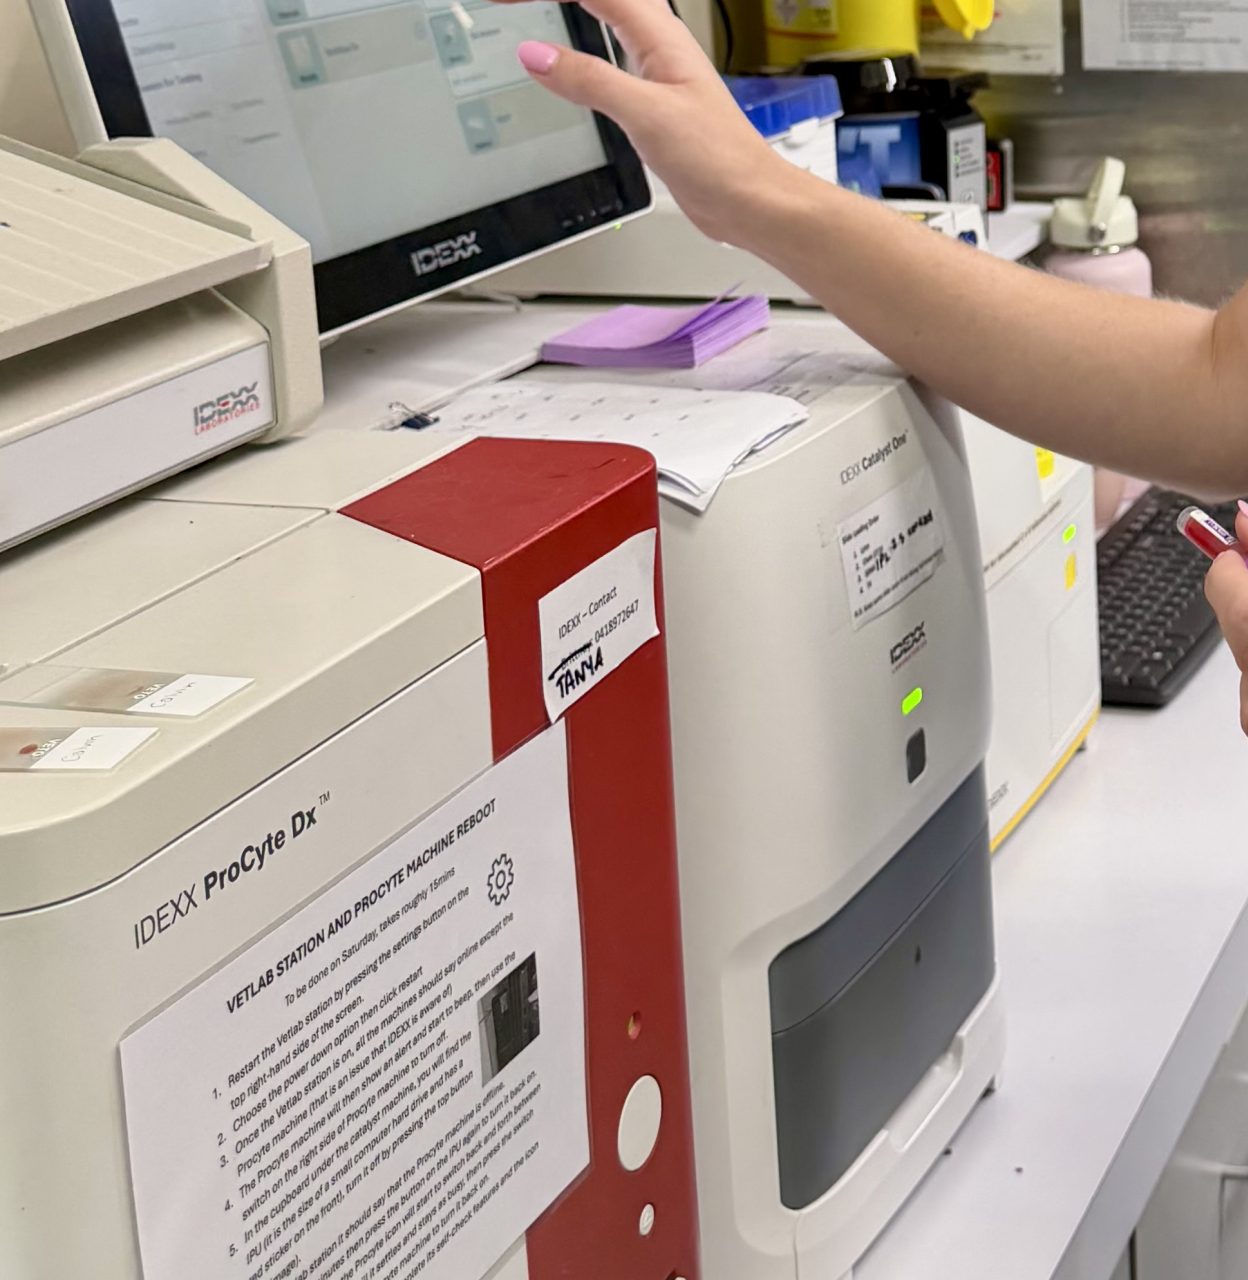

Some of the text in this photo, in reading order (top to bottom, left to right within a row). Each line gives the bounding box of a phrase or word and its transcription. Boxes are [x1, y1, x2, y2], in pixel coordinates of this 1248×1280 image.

[411, 229, 483, 277] IDEXX
[193, 381, 259, 427] IDEXX
[194, 401, 260, 436] LABORATORIES
[862, 442, 892, 470] Catalyst
[556, 646, 604, 699] TANYA
[558, 611, 582, 640] IDEXX
[588, 586, 618, 617] Contact
[595, 599, 639, 643] 0418972647
[890, 620, 926, 665] IDEXX
[134, 883, 199, 950] IDEXX
[204, 829, 286, 900] ProCyte
[291, 806, 318, 839] Dx
[225, 797, 496, 1014] VETLAB STATION AND PROCYTE MACHINE REBOOT
[284, 866, 456, 1007] To be done on Saturday, takes roughly 15mins
[211, 885, 469, 1100] 1. Restart the Vetlab station by pressing the settings button on the
[216, 964, 423, 1146] 2. Choose the power down option then click restart
[219, 911, 514, 1168] 3. Once the Vetlab station is on, all the machines should say online except the
[229, 994, 364, 1110] top right-hand side of the screen.
[223, 950, 516, 1212] 4. The Procyte machine will then show an alert and start to beep, then use the
[236, 982, 453, 1177] Procyte machine (that is an issue that IDEXX is aware of)
[241, 1028, 448, 1222] switch on the right side of Procyte machine to turn off.
